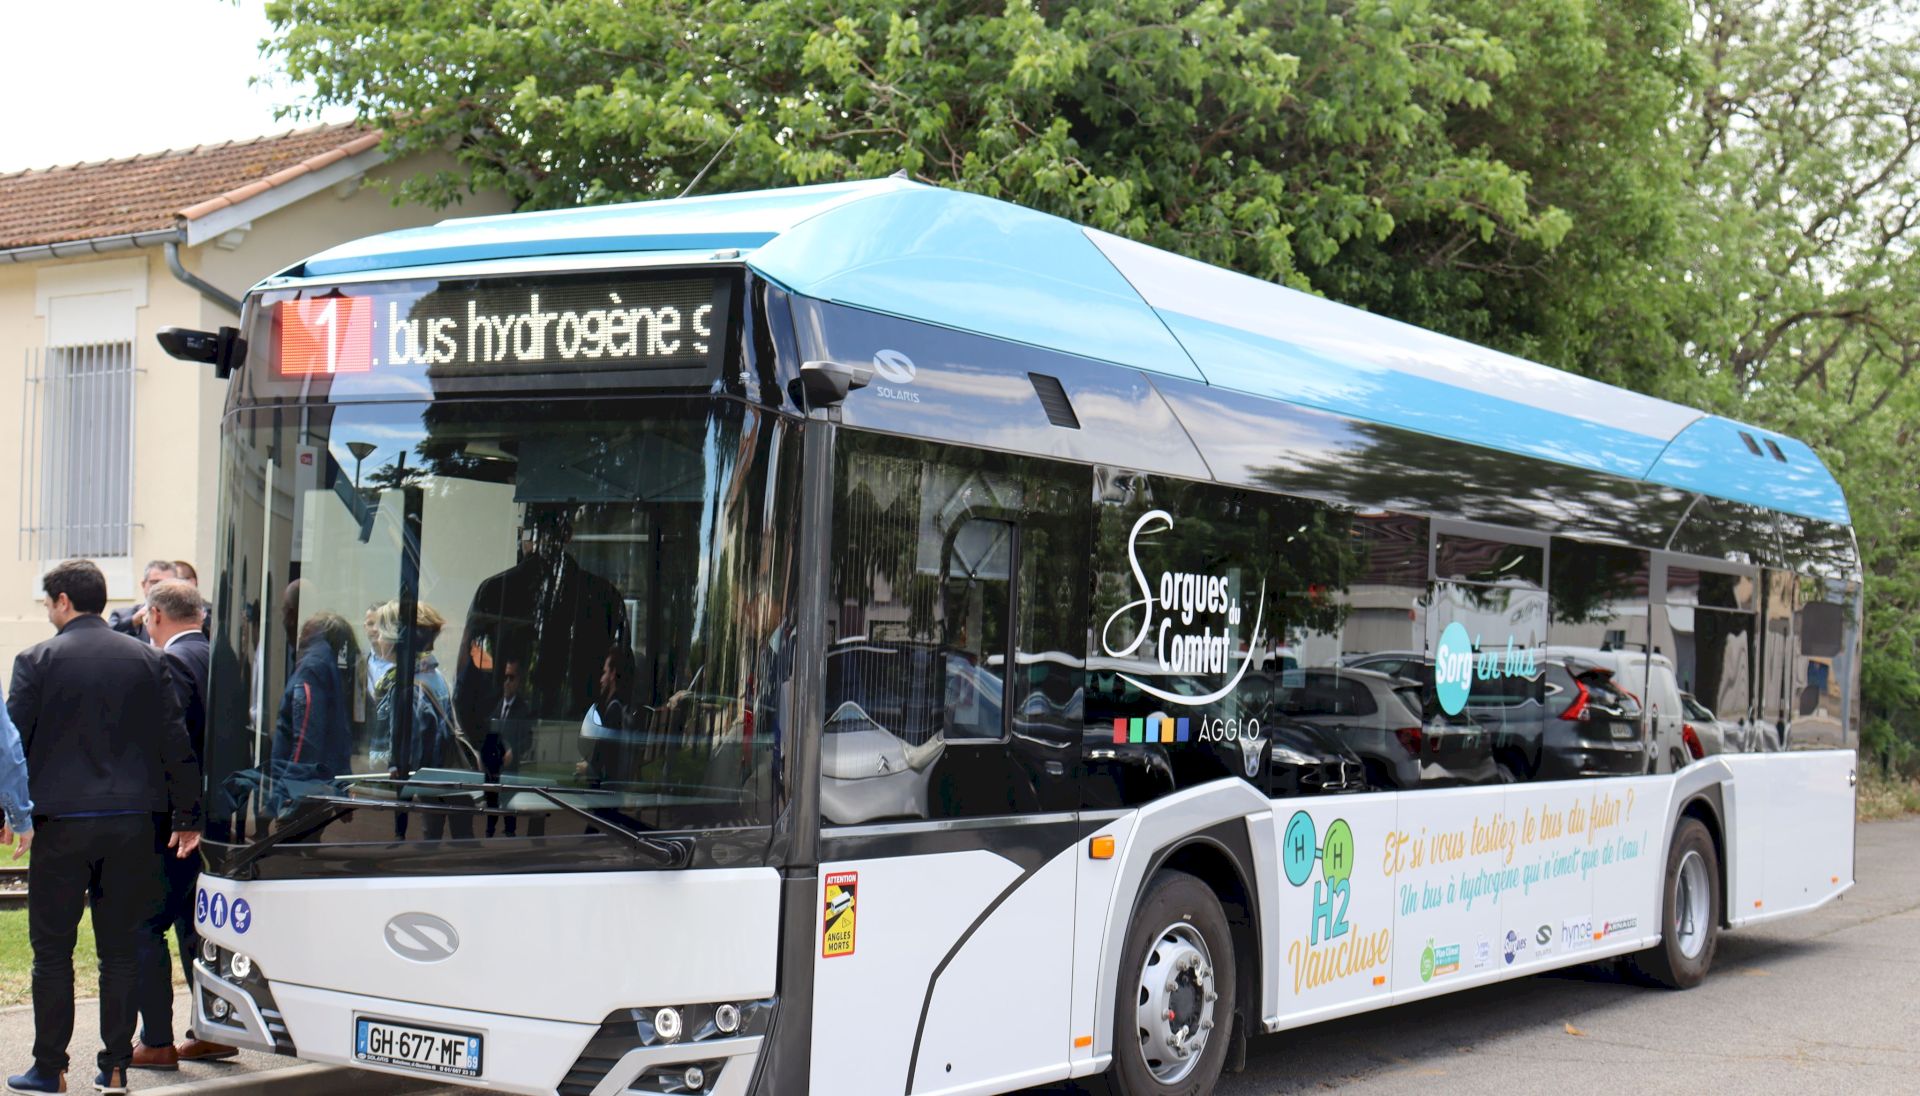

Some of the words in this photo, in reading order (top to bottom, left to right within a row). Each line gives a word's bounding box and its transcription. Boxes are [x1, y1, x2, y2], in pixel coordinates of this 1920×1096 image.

[315, 298, 337, 373] 1
[387, 301, 458, 365] bus
[467, 292, 681, 363] hydrogène
[877, 386, 920, 403] SOLARIS
[1102, 509, 1229, 657] Sorgues
[1228, 598, 1241, 625] du
[1158, 617, 1230, 674] Comtat
[1504, 633, 1537, 678] bus
[1295, 833, 1305, 864] H
[1333, 842, 1343, 870] H
[1383, 831, 1410, 877] Et
[1410, 827, 1425, 869] si
[1430, 830, 1465, 864] vous
[1470, 812, 1518, 865] testiez
[1521, 807, 1536, 845] le
[1540, 803, 1562, 840] bus
[1568, 798, 1585, 834] du
[1588, 791, 1621, 845] futur
[827, 875, 856, 885] ATTENTION
[1400, 883, 1418, 916] Un
[1422, 880, 1442, 910] bus
[1447, 874, 1455, 904] à
[1459, 864, 1520, 912] hydrogène
[1523, 855, 1541, 896] qui
[1581, 848, 1599, 881] que
[1602, 839, 1614, 865] de
[1616, 836, 1639, 862] l'eau
[1311, 875, 1351, 946] H2
[827, 931, 851, 942] ANGLES
[828, 941, 850, 951] MORTS
[1288, 924, 1391, 996] Vaucluse
[370, 1027, 465, 1066] GH-677-MF
[467, 1056, 478, 1070] 69
